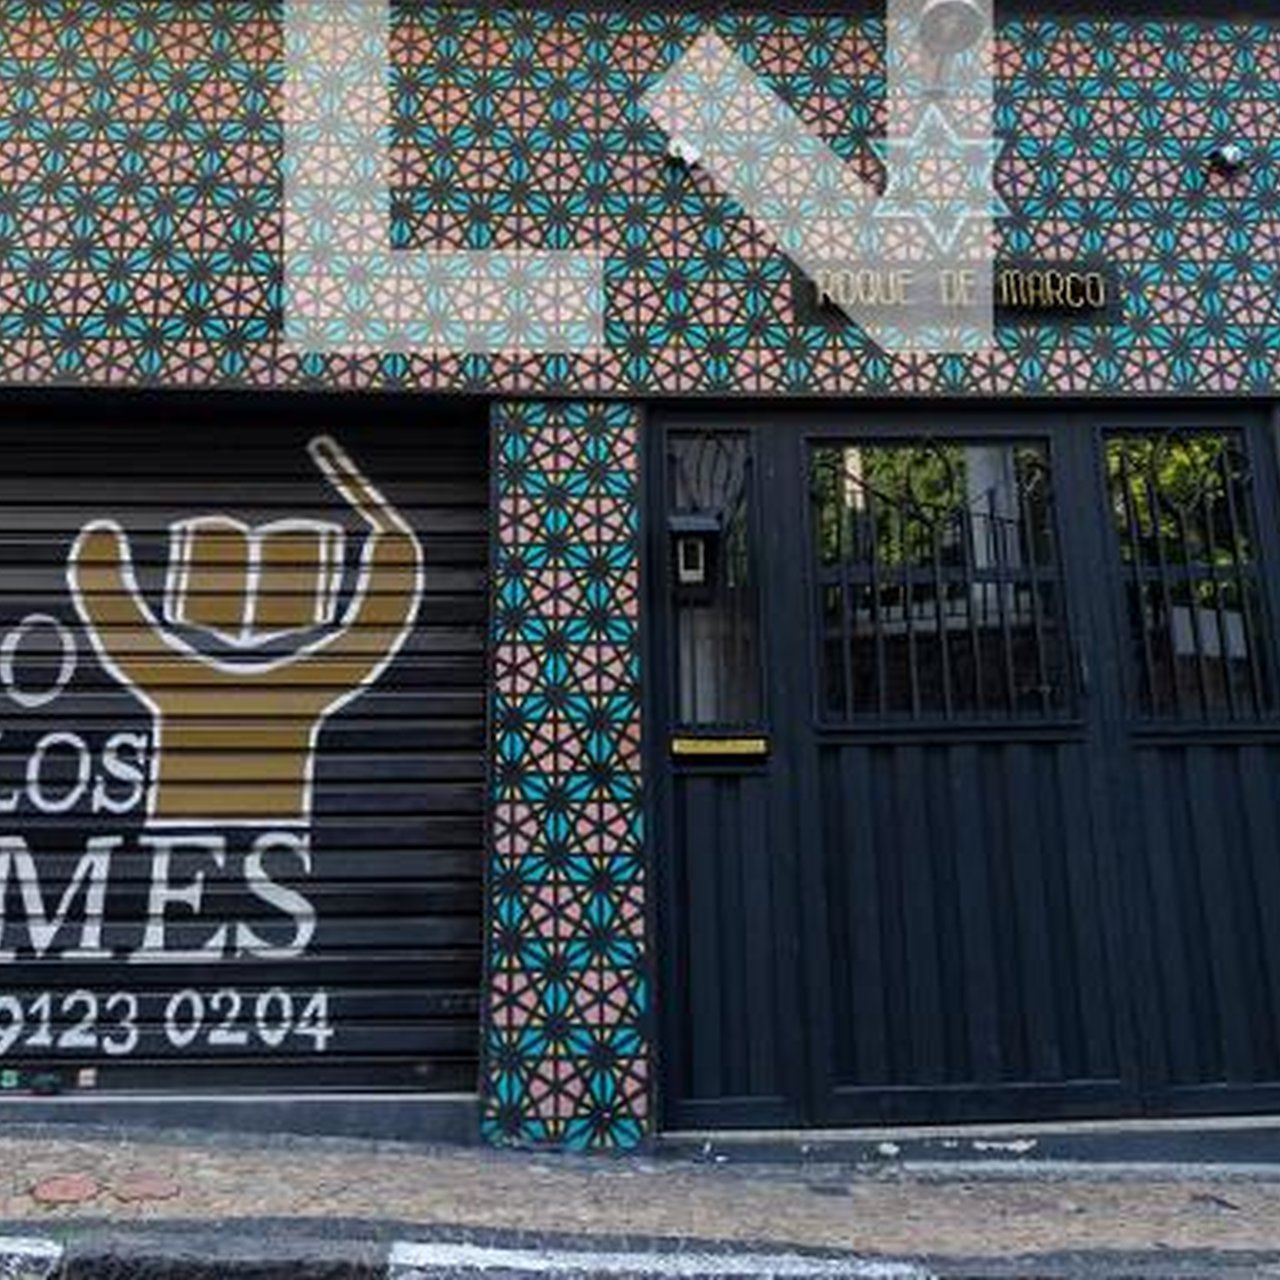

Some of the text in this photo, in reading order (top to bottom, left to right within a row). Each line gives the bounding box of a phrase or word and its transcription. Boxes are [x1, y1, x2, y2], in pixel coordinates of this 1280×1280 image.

[940, 269, 976, 307] DE
[999, 270, 1106, 308] MARCO
[164, 988, 334, 1052] 0204
